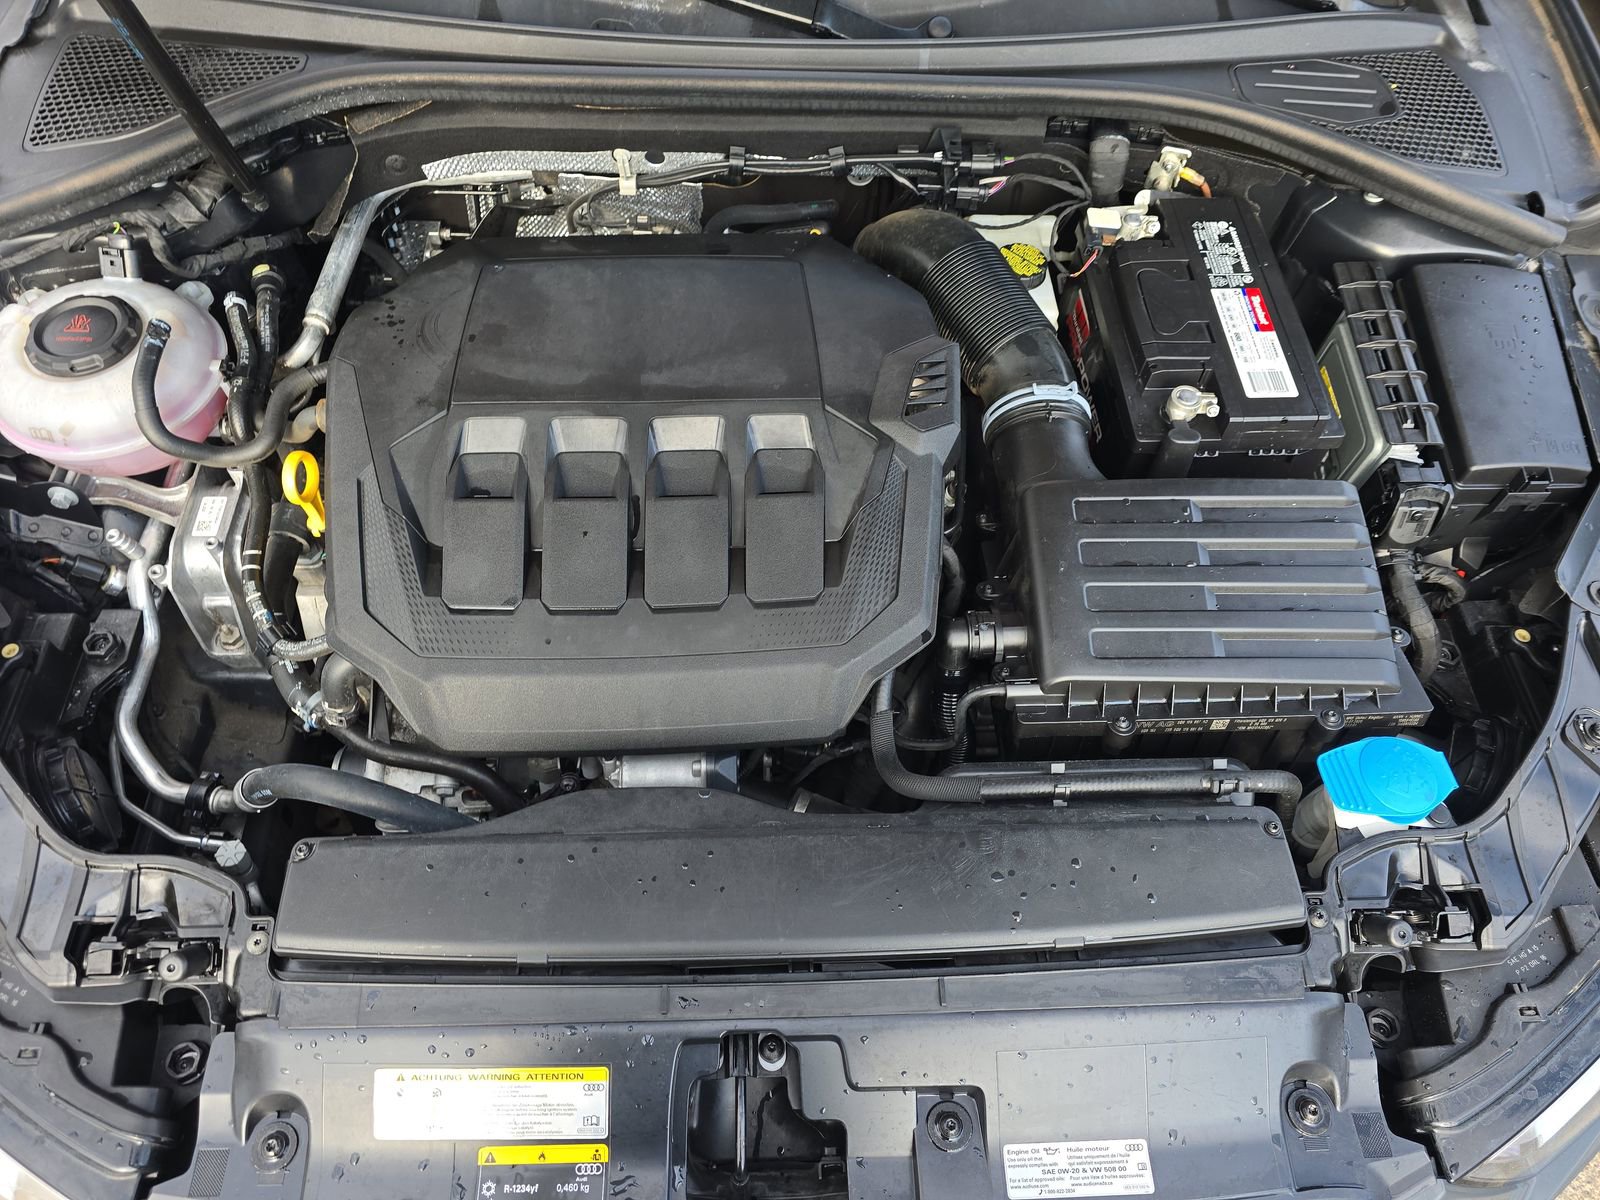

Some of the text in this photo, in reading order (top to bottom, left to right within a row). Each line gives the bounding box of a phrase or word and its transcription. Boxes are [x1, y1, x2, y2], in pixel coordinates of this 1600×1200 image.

[1507, 956, 1519, 966] SAE
[468, 1073, 520, 1081] WARNING
[526, 1072, 584, 1081] ATTENTION
[1057, 1167, 1080, 1175] 0W-20
[503, 1183, 590, 1194] R-1234yf 0,460 kg
